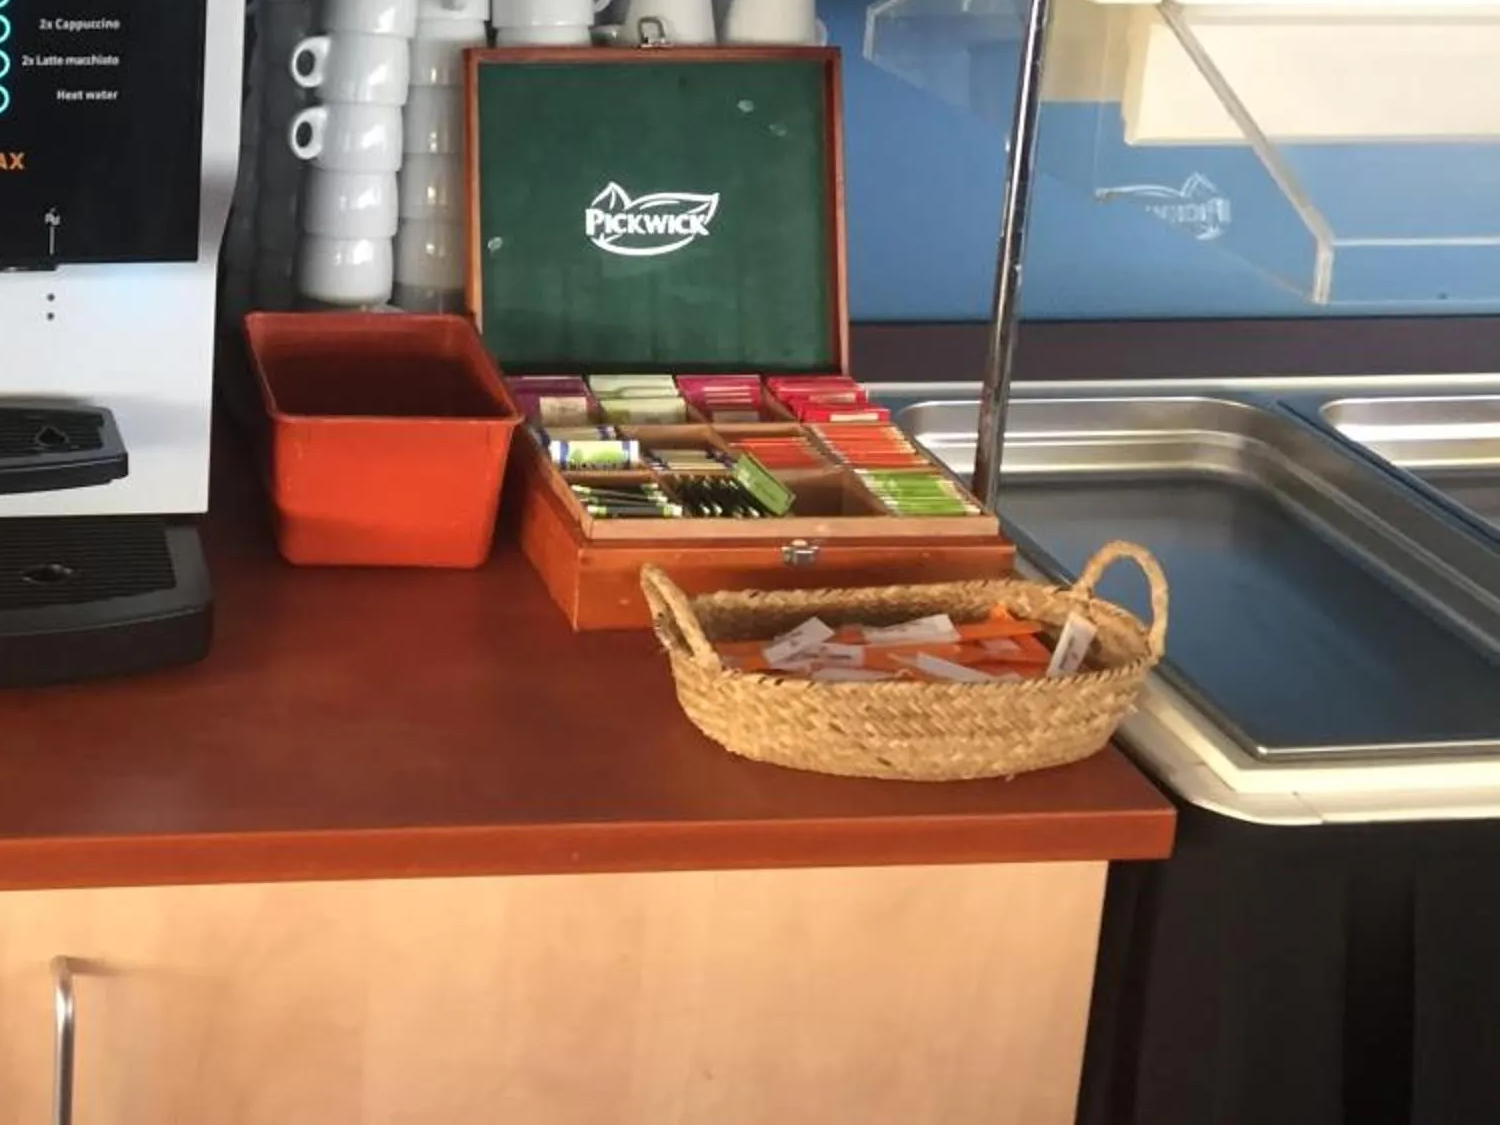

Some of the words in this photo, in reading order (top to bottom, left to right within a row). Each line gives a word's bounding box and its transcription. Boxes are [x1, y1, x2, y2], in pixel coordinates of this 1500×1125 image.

[39, 18, 54, 30] 2x
[54, 17, 121, 33] Cappuccino
[21, 54, 34, 66] 2x
[35, 54, 64, 66] Latte
[65, 54, 120, 66] macchiato
[85, 89, 119, 101] water
[585, 208, 710, 236] PICKWICK
